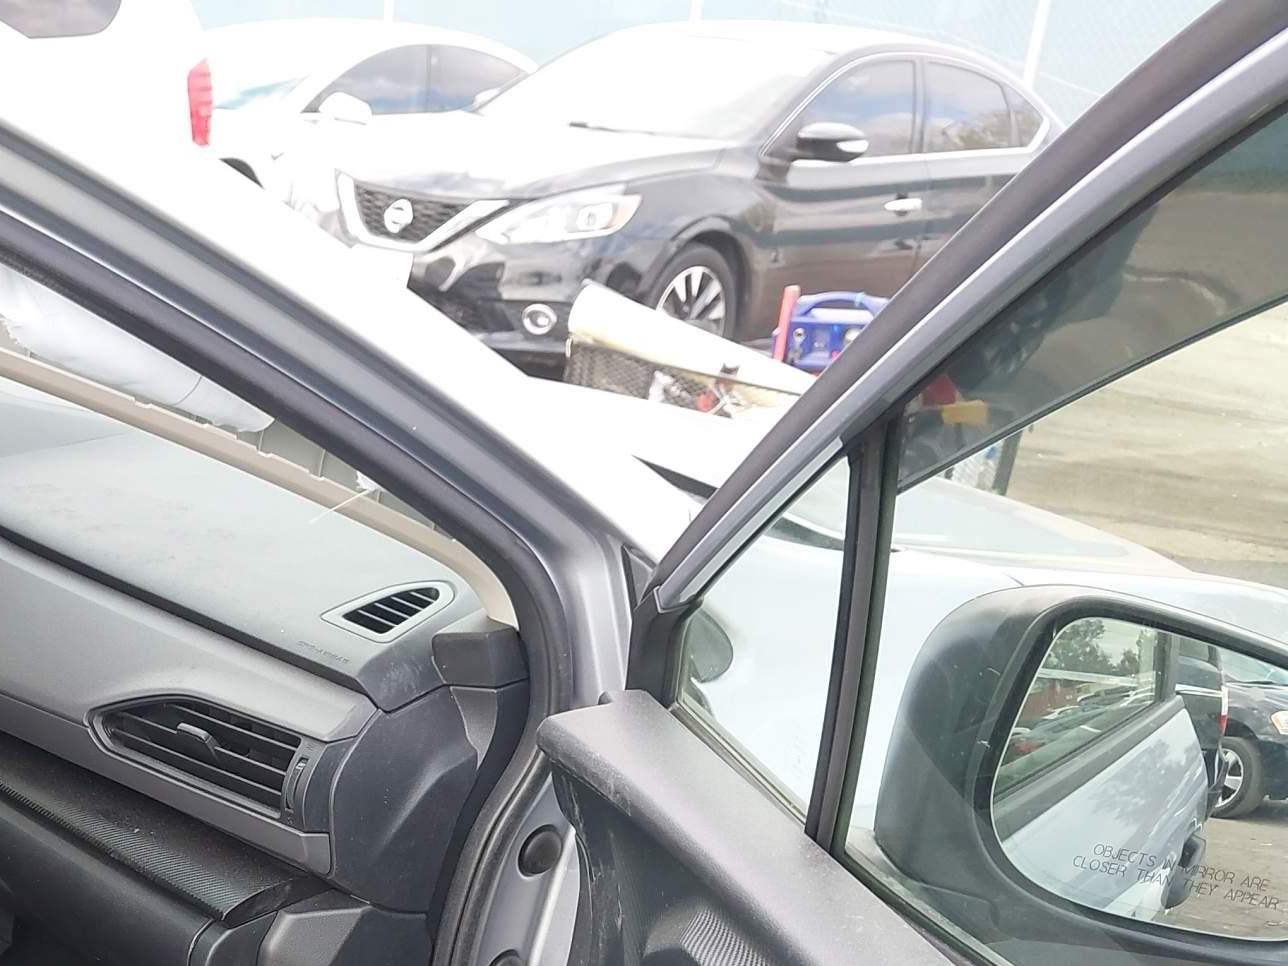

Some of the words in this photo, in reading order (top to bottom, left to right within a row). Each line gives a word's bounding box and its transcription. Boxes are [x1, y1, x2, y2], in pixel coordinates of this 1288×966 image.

[1073, 855, 1128, 877] CLOSER
[1136, 867, 1174, 887] THAN
[1183, 878, 1219, 895] THEY
[1224, 888, 1280, 911] APPEAR
[1093, 844, 1156, 867] OBJECTS
[1240, 875, 1270, 892] ARE
